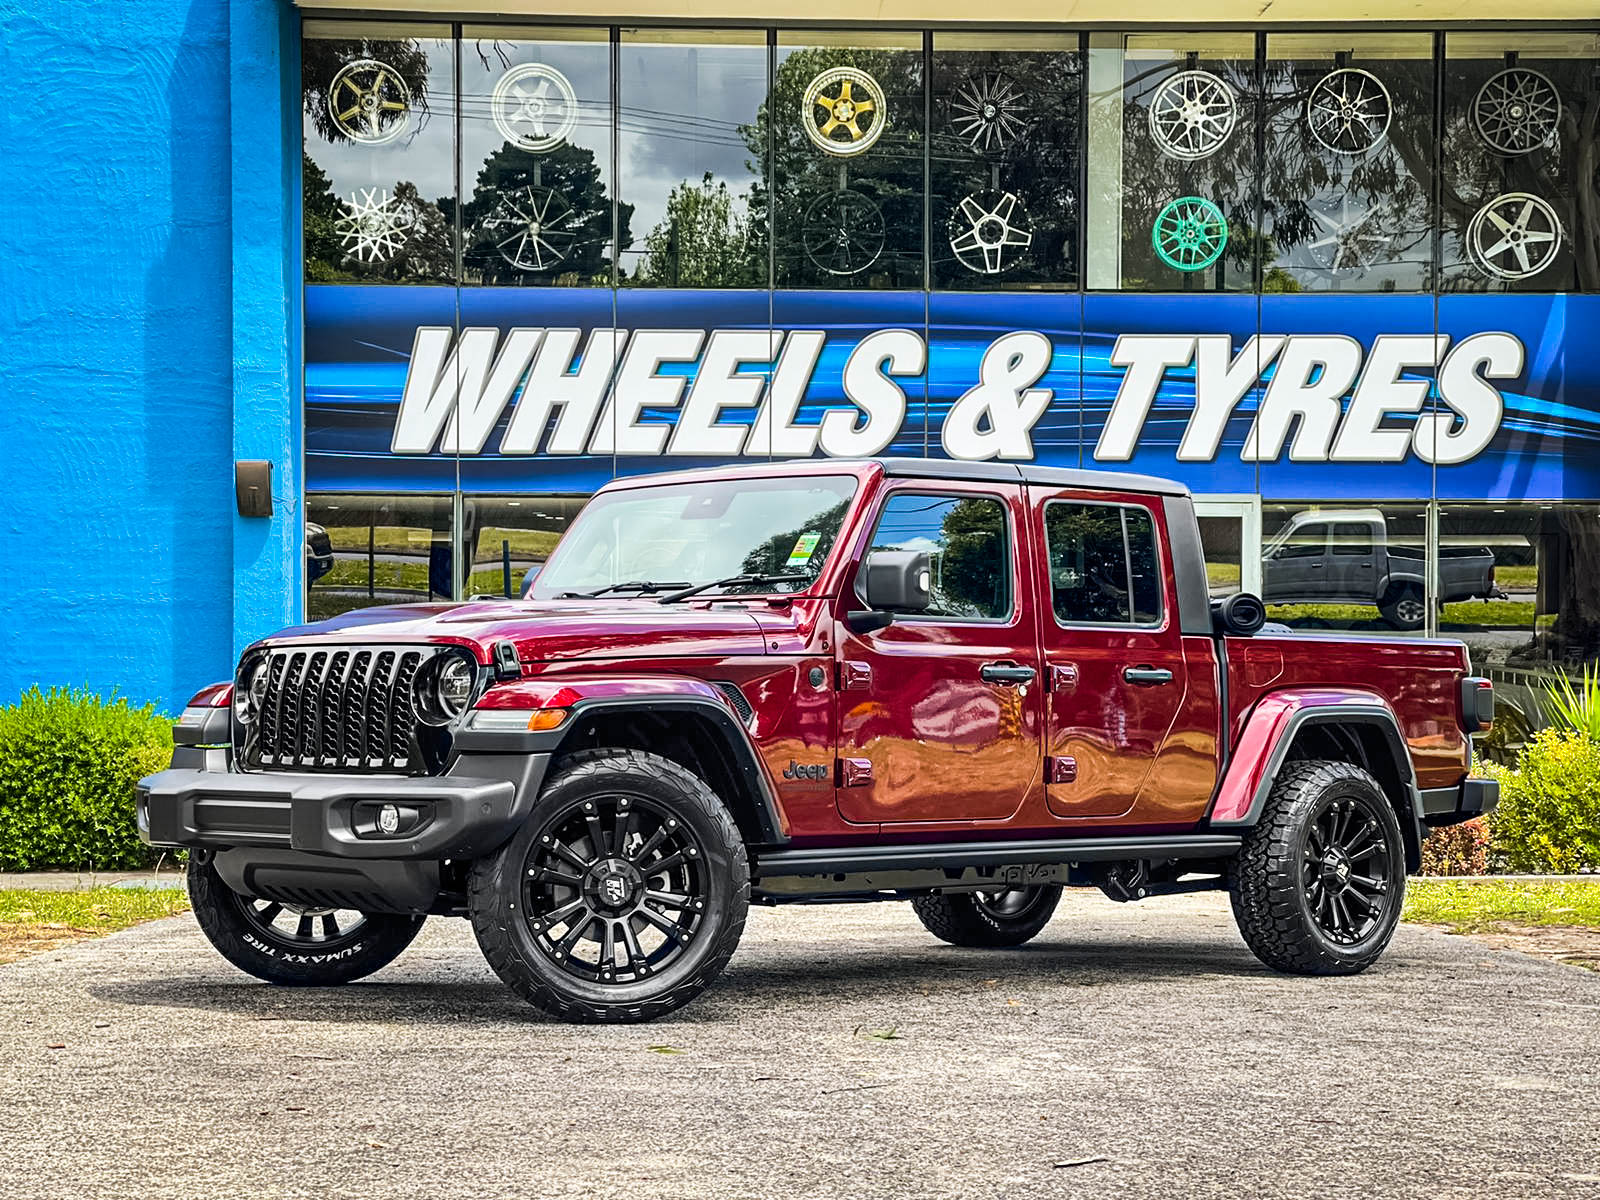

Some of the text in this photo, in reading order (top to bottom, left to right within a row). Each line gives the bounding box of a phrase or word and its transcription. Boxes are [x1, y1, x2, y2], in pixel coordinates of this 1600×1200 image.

[391, 326, 1525, 464] WHEELS & TYRES
[782, 759, 828, 782] Jeep
[242, 933, 363, 963] SUMAXX TIRE
